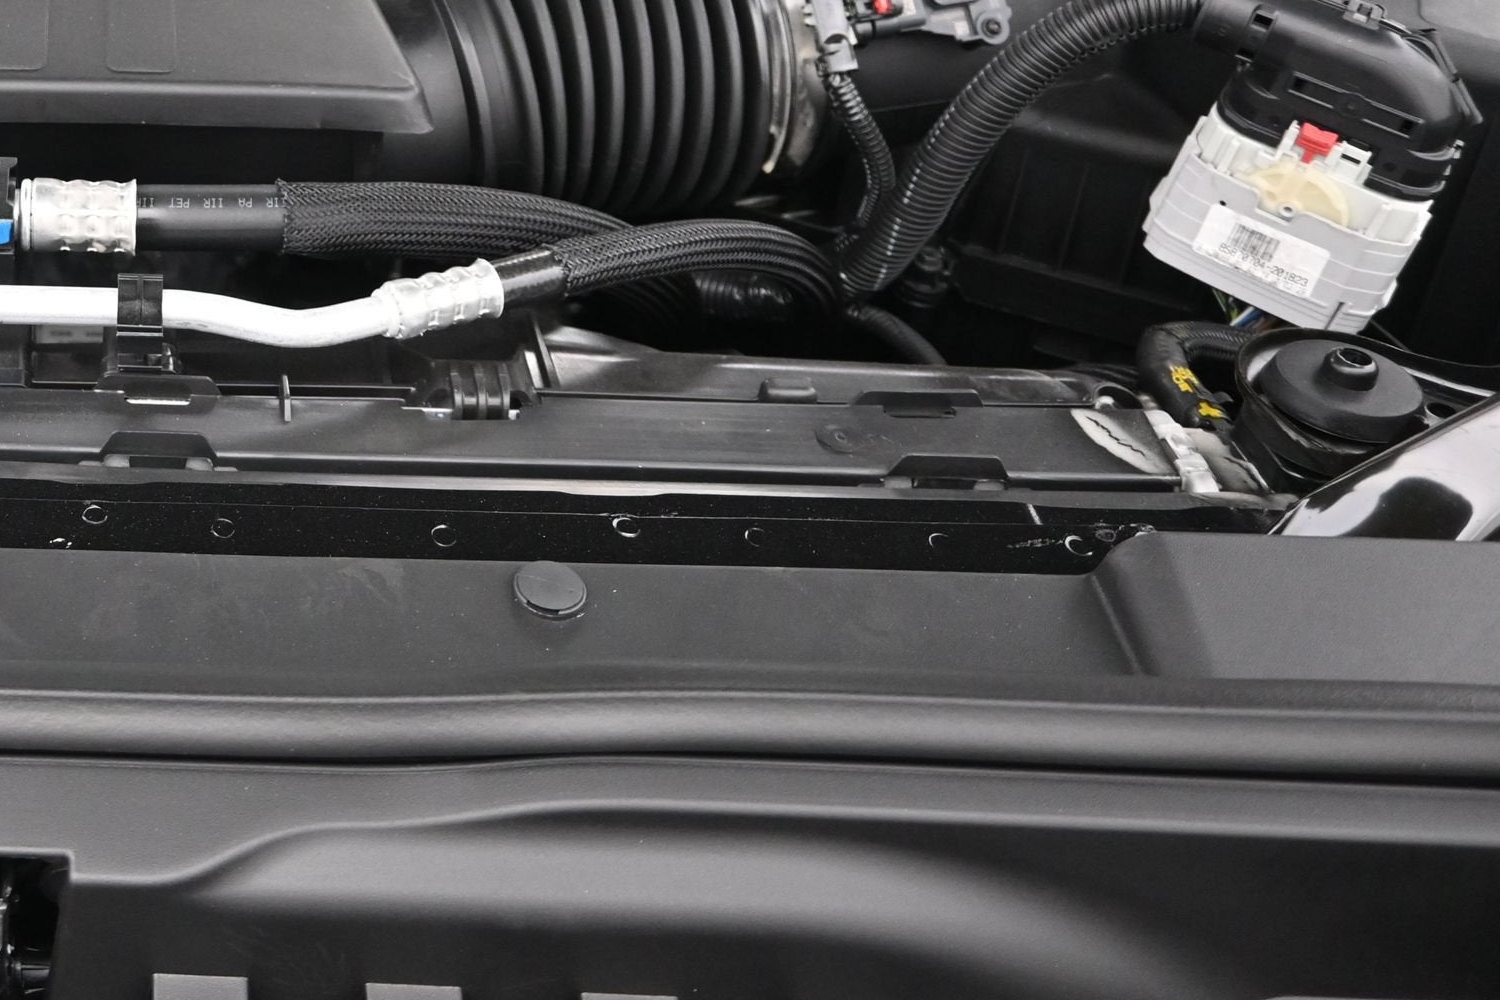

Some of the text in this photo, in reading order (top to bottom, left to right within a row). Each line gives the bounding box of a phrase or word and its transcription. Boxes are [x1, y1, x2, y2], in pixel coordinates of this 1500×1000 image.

[168, 197, 190, 209] PET
[203, 197, 224, 209] IIR
[238, 197, 253, 208] PA
